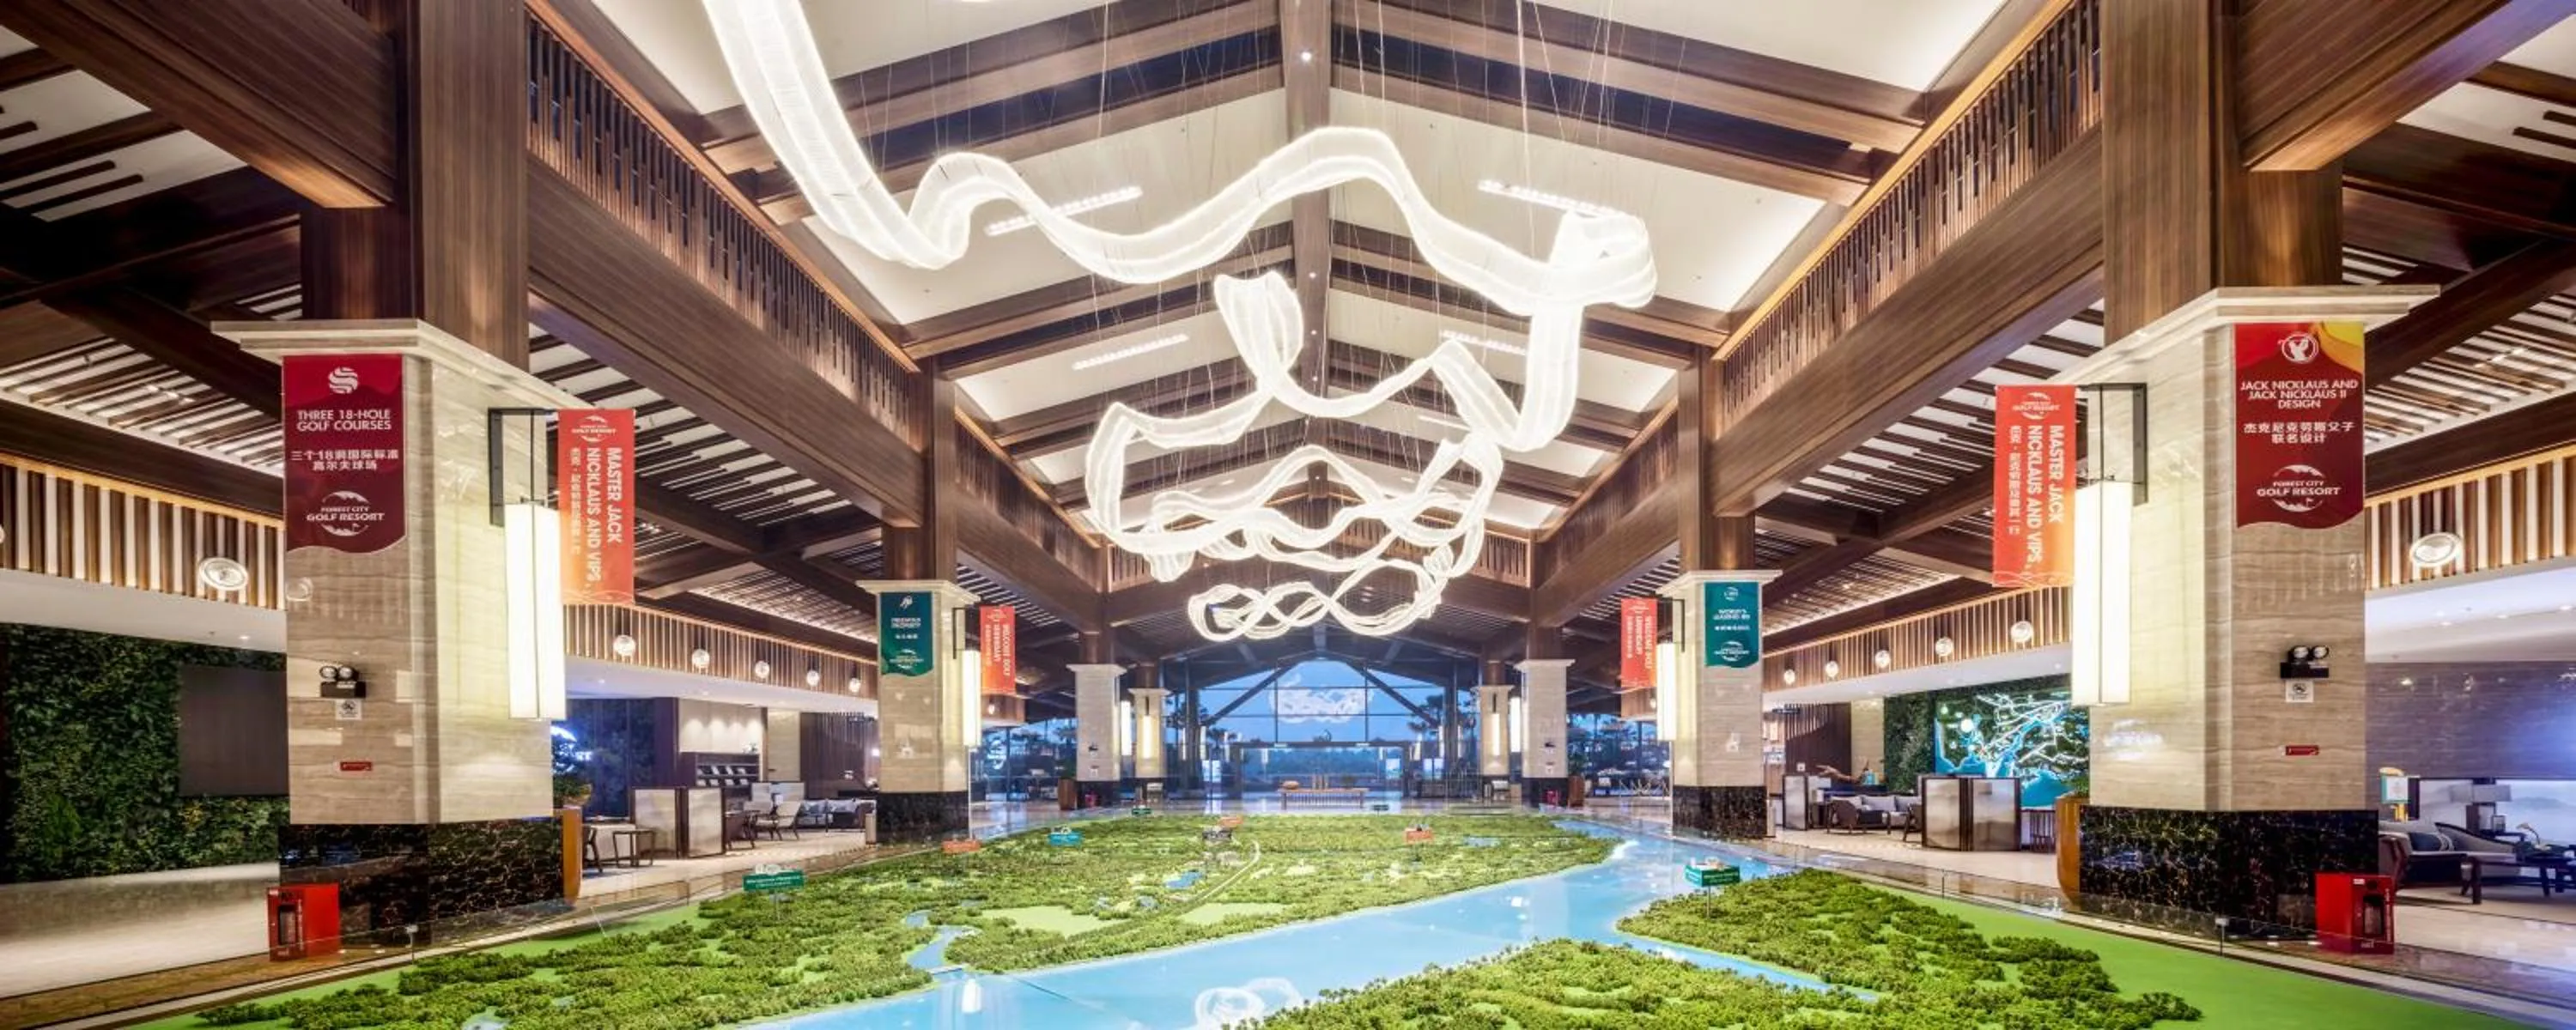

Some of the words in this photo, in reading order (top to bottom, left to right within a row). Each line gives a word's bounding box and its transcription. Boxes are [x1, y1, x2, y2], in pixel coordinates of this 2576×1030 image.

[2240, 380, 2269, 391] JACK
[2271, 380, 2328, 390] NICKLAUS
[2331, 379, 2358, 389] AND
[2248, 390, 2277, 400] JACK
[2280, 389, 2336, 399] NICKLAUS
[2340, 389, 2347, 398] II
[2277, 399, 2321, 409] DESIGN
[297, 409, 334, 420] THREE
[338, 409, 392, 419] 18-HOLE
[296, 421, 331, 432] GOLF
[334, 420, 392, 430] COURSES
[2271, 432, 2326, 444] 联名设计
[2049, 425, 2064, 481] MASTER
[313, 460, 378, 471] 高尔夫球场
[2027, 425, 2043, 495] NICKLAUS
[607, 447, 623, 501] MASTER
[586, 447, 601, 515] NICKLAUS
[2257, 488, 2291, 497] GOLF
[2292, 487, 2342, 496] RESORT
[2048, 483, 2064, 524] JACK
[306, 513, 337, 522] GOLF
[339, 512, 386, 522] RESORT
[2027, 498, 2043, 529] AND
[607, 504, 623, 544] JACK
[586, 518, 601, 548] AND
